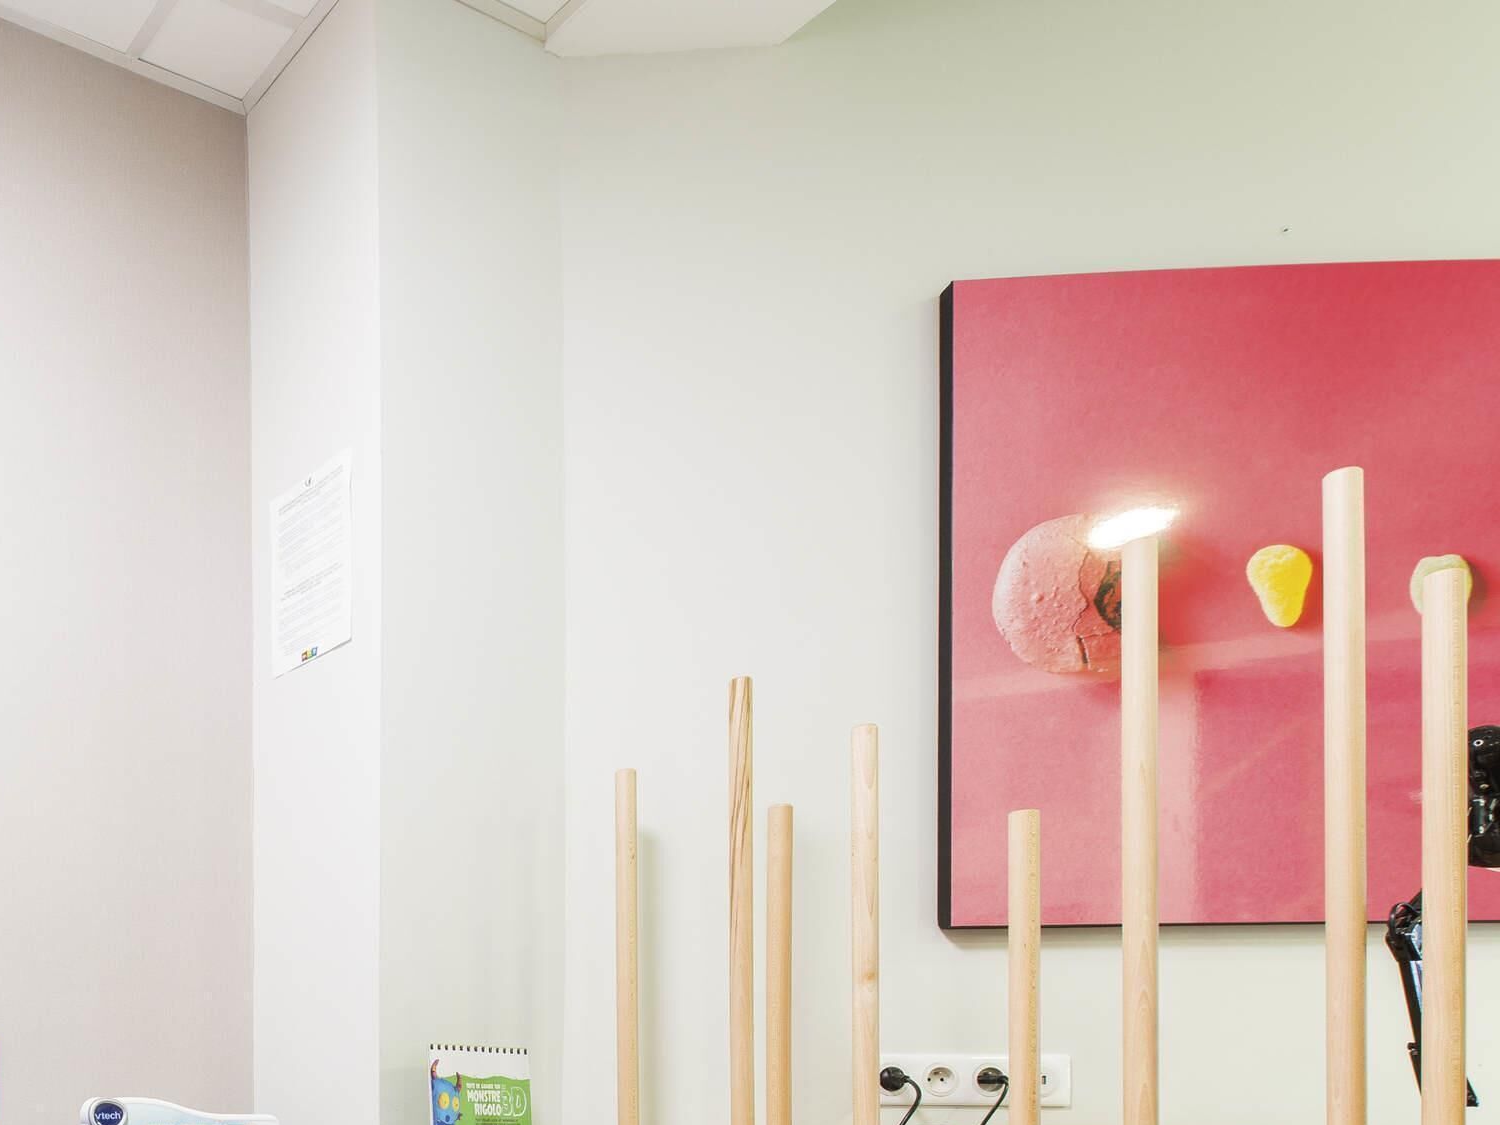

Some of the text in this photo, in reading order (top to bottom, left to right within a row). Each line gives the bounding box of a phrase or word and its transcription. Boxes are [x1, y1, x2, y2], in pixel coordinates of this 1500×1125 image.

[467, 1090, 501, 1103] MONSTRE
[94, 1110, 121, 1121] vtech
[474, 1103, 502, 1117] RIGOLO
